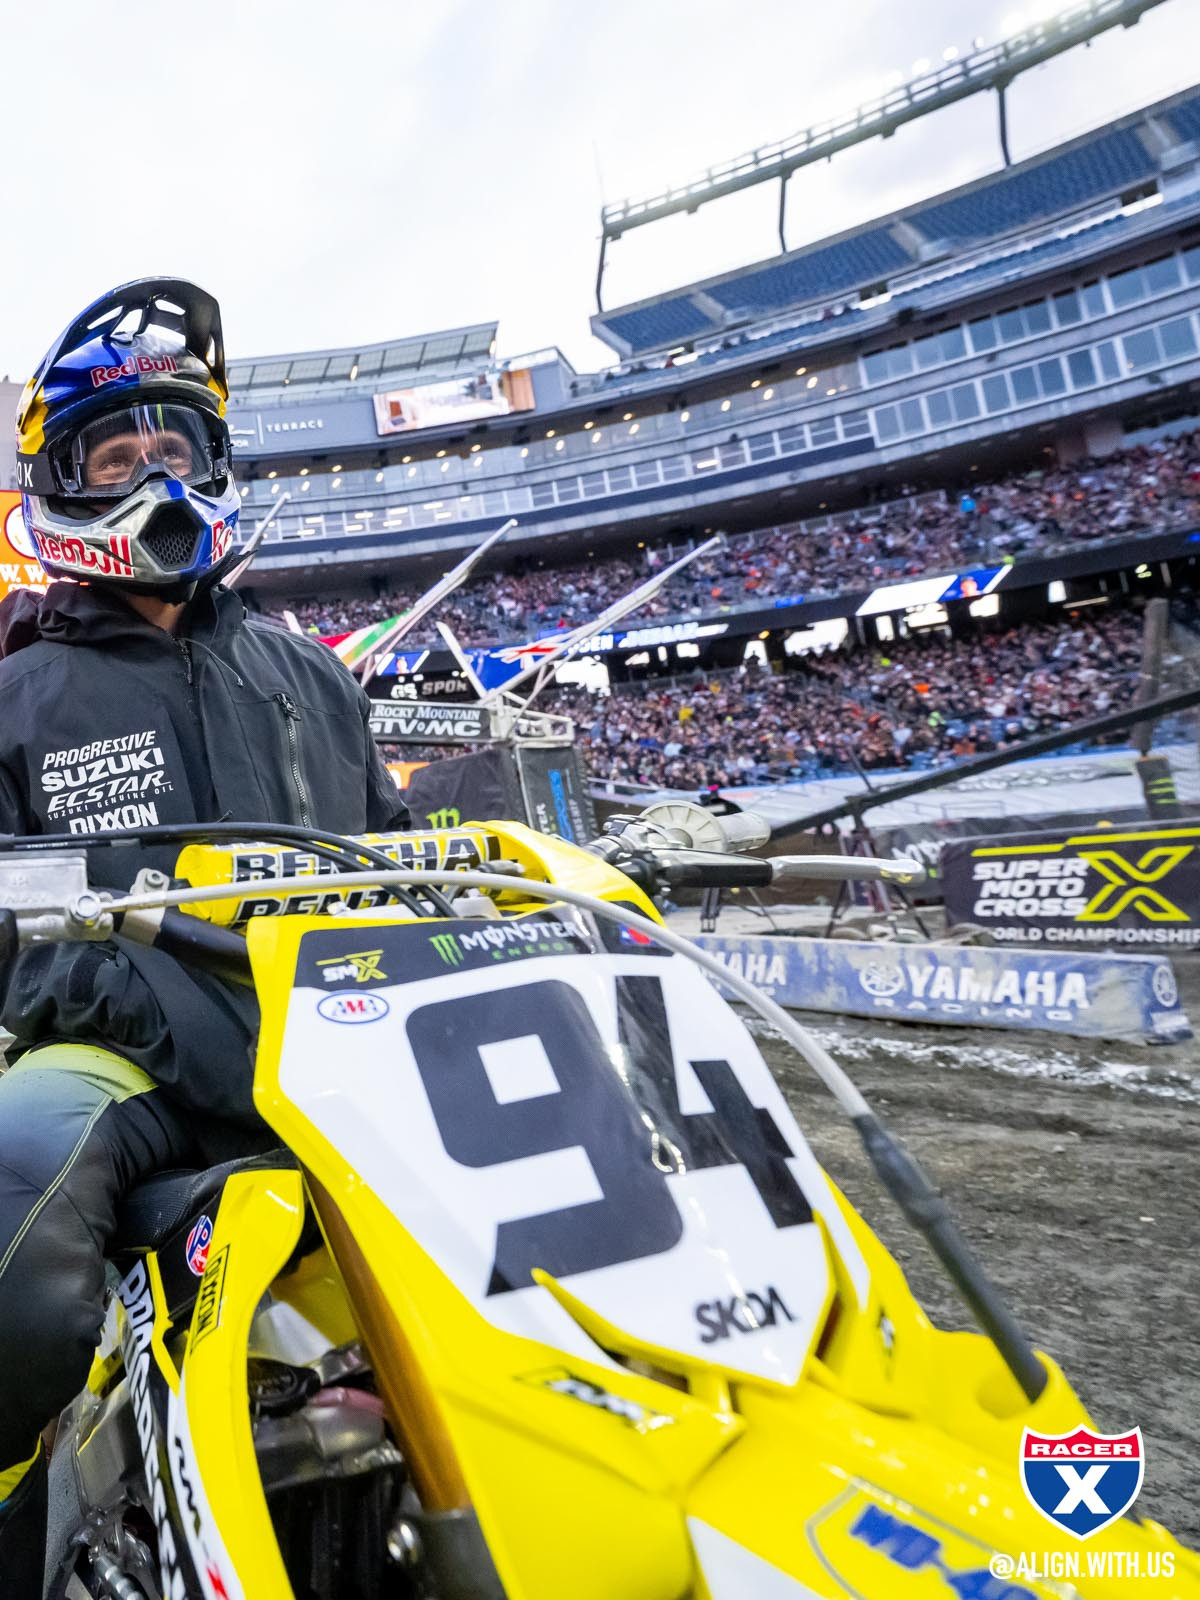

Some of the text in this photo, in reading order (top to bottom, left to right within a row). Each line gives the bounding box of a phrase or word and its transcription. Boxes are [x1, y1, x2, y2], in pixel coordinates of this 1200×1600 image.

[91, 354, 179, 388] Red Bull
[266, 418, 324, 433] TERRACE
[374, 704, 481, 721] ROCKY MOUNTAIN
[42, 730, 156, 770] PROGRESSIVE
[41, 747, 165, 793] SUZUKI
[47, 770, 172, 814] ECSTAR
[48, 784, 174, 820] SUZUKI GENUINE OIL
[68, 801, 160, 835] DIXXON
[972, 857, 1090, 881] SUPER
[979, 877, 1086, 899] MOTO
[972, 896, 1090, 918] CROSS
[458, 920, 588, 951] MONSTER
[991, 927, 1043, 942] ORLD
[321, 955, 388, 983] SMX
[906, 964, 1091, 1010] YAMAHA
[331, 999, 380, 1016] AMA
[872, 997, 1074, 1022] RACING
[405, 975, 818, 1299] 94
